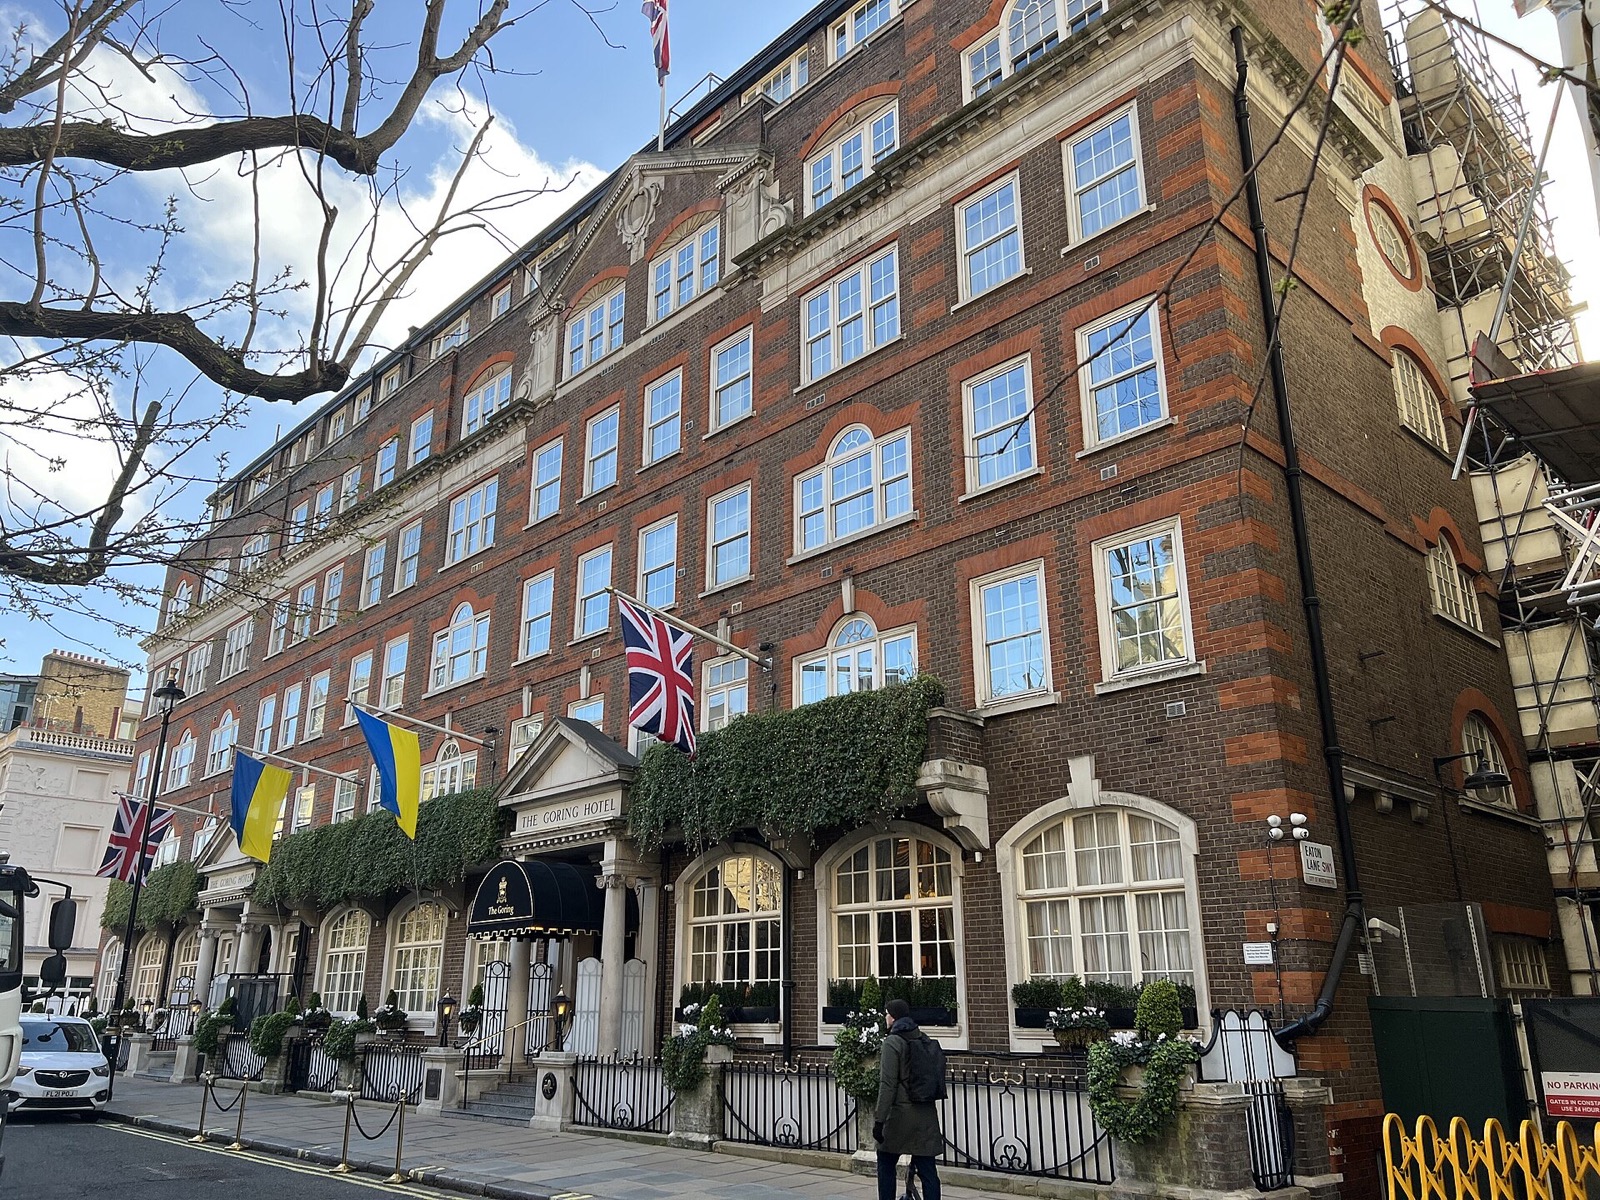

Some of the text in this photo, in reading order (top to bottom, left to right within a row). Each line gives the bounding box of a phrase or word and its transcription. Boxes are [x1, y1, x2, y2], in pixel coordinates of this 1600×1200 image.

[522, 798, 616, 828] THE GORING HOTEL
[1305, 846, 1322, 858] EATON
[1307, 859, 1321, 871] LANE
[488, 905, 514, 915] The Goring
[1547, 1081, 1600, 1090] NO PARKIN
